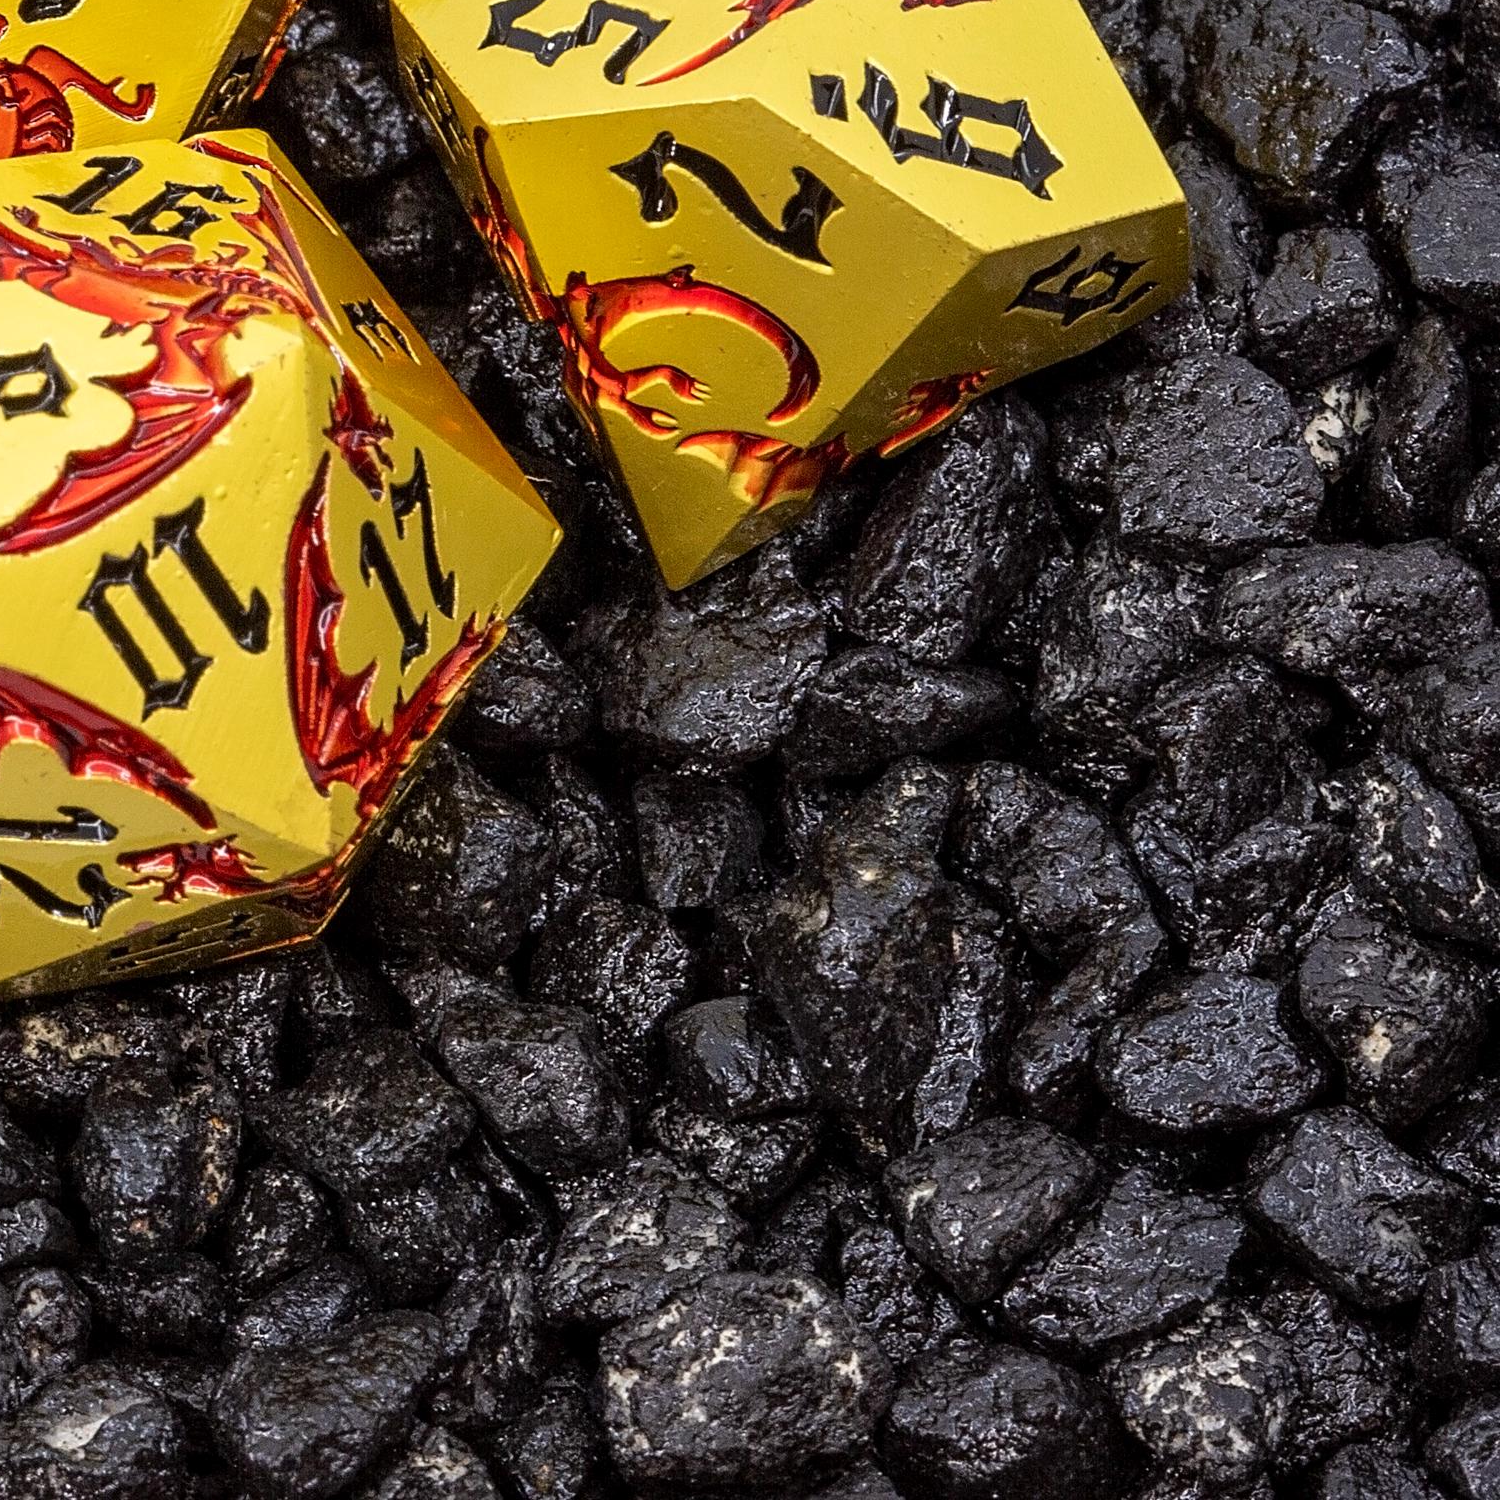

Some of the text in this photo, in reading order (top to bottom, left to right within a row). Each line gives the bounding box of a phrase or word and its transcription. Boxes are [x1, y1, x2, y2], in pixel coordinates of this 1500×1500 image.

[32, 155, 247, 239] 16
[77, 497, 272, 720] 10
[362, 448, 458, 671] 17
